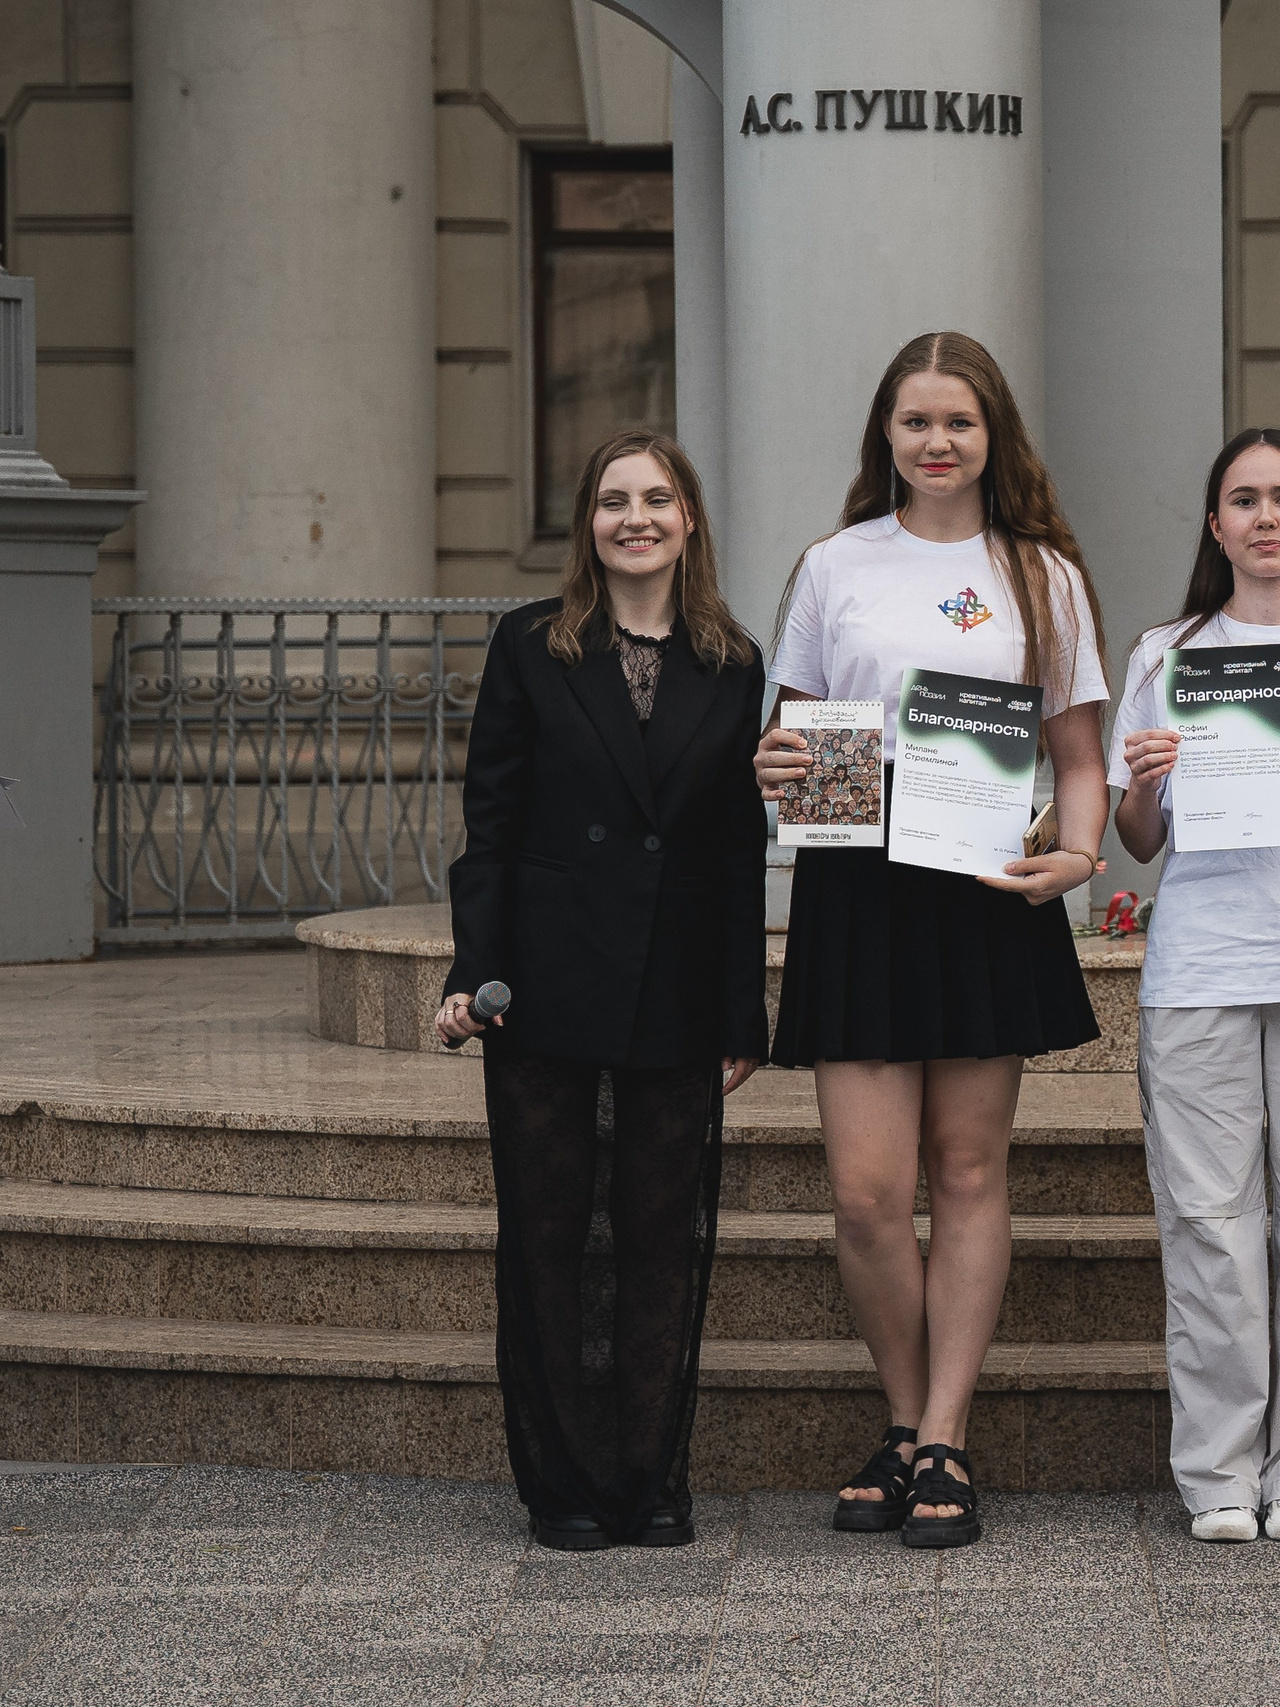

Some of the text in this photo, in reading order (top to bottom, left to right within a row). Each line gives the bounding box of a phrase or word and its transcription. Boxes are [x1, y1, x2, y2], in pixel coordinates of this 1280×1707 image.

[739, 88, 1023, 136] А.С. ПУШКИН
[958, 698, 987, 707] капитал
[908, 708, 1030, 739] Благодарность
[1178, 724, 1208, 732] Софии
[1180, 733, 1219, 741] Рыжовой
[905, 743, 938, 755] Милане
